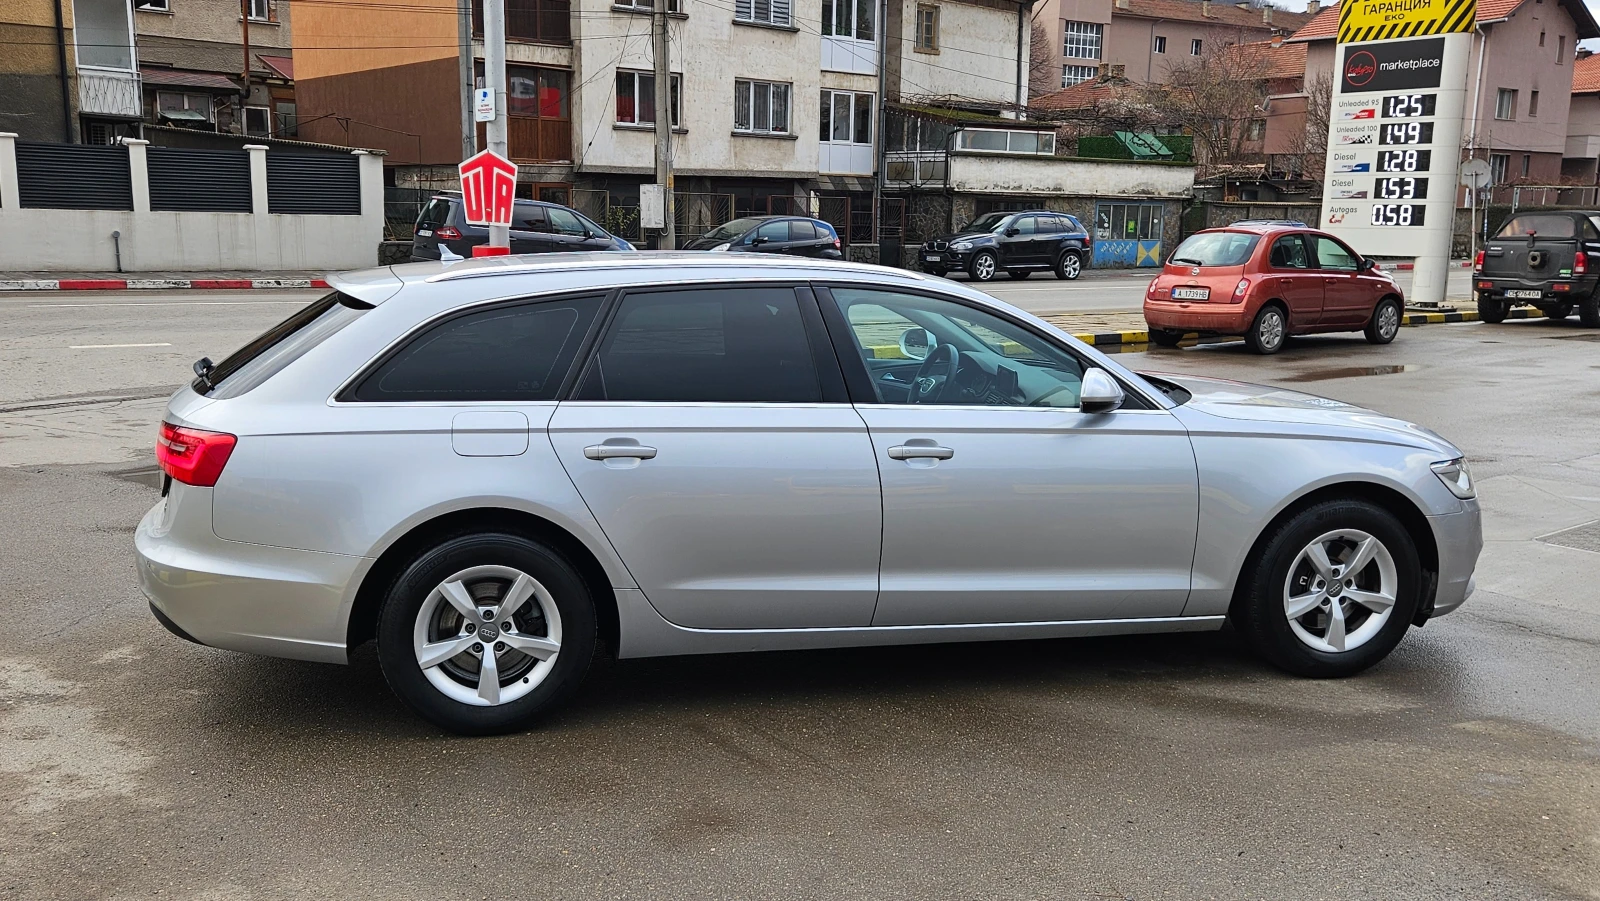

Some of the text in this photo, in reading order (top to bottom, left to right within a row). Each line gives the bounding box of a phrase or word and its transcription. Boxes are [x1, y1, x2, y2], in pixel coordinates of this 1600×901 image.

[1363, 0, 1431, 15] ГАРАНЦИЯ
[1384, 13, 1405, 21] EKO
[1380, 58, 1440, 71] marketplace
[1338, 100, 1370, 108] Unleaded
[1389, 94, 1422, 117] 1.25
[1386, 122, 1420, 144] 1.49
[1383, 149, 1418, 172] 1.28
[1331, 179, 1354, 187] Diesel
[1381, 177, 1415, 199] 1.53
[1329, 206, 1358, 215] Autogas
[1371, 204, 1412, 226] 0.58
